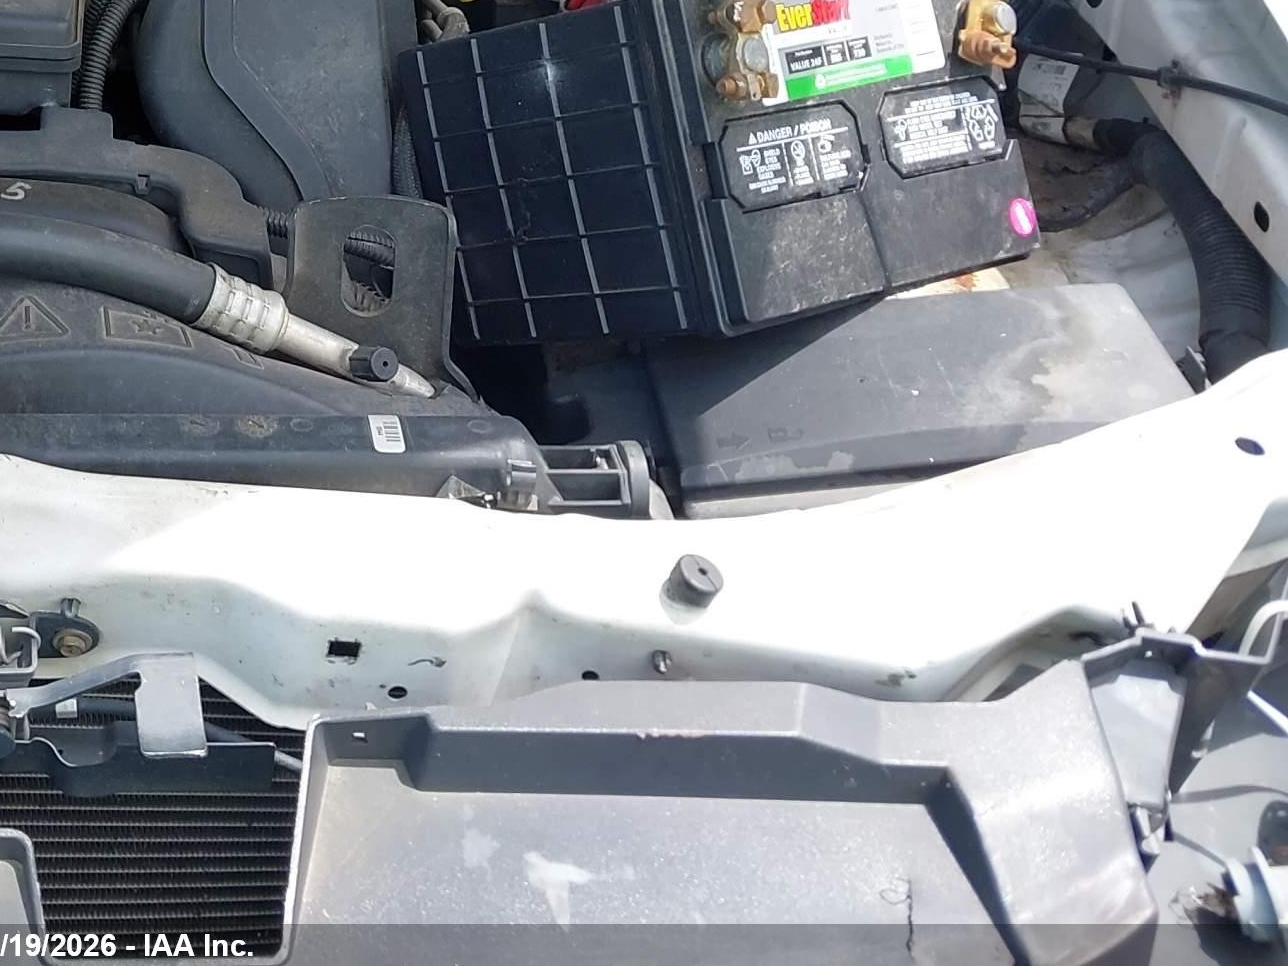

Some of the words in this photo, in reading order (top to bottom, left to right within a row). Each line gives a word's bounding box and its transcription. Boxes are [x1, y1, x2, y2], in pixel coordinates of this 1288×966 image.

[790, 59, 811, 73] VALUE
[756, 127, 793, 143] DANGER
[799, 118, 832, 135] POISON
